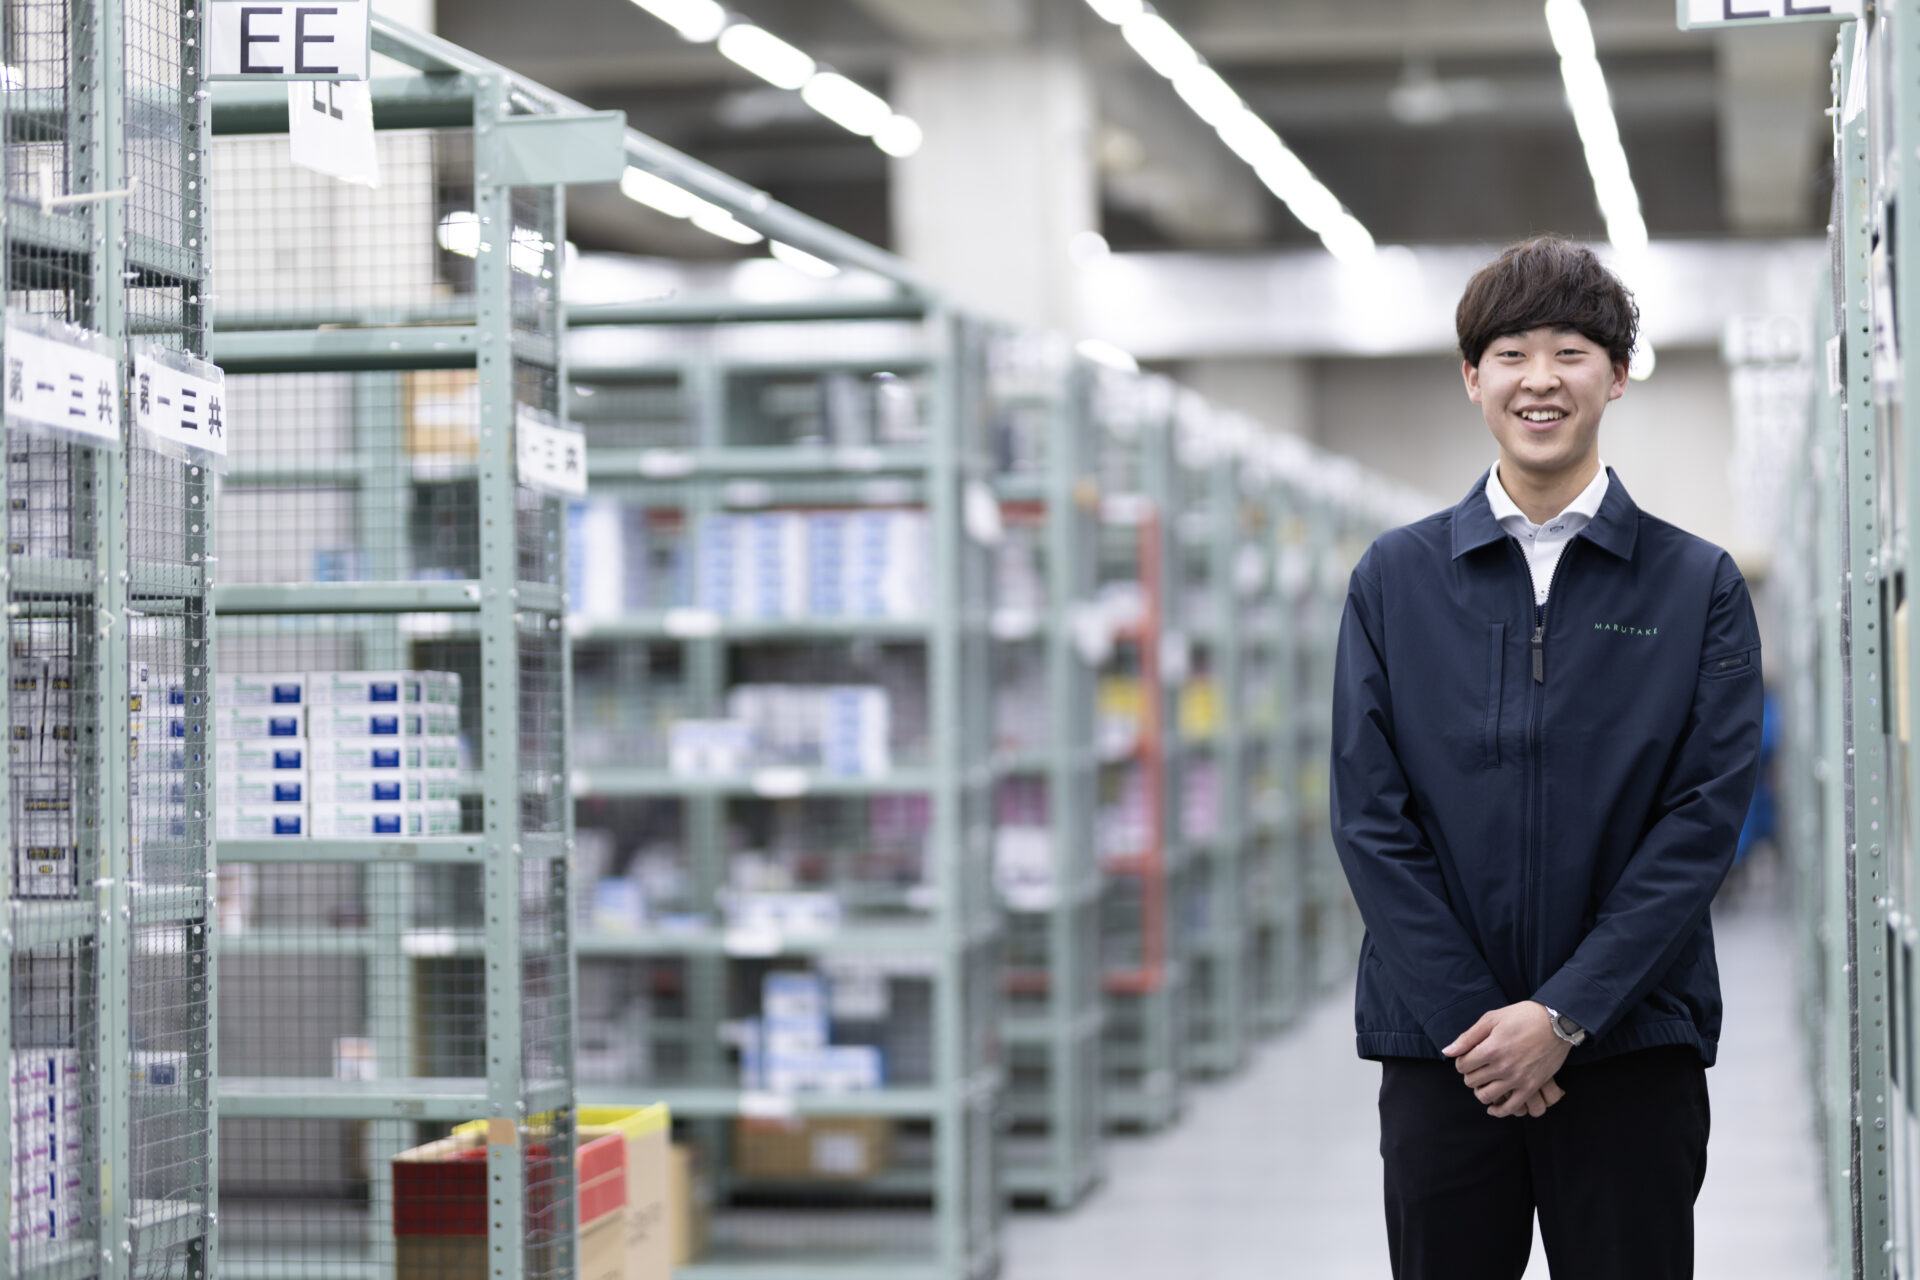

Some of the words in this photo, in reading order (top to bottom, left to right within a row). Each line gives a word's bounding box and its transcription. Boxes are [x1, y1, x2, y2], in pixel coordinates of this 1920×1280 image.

[240, 7, 339, 74] EE
[140, 373, 222, 438] 第一三共
[1594, 622, 1658, 635] MARUTAKE
